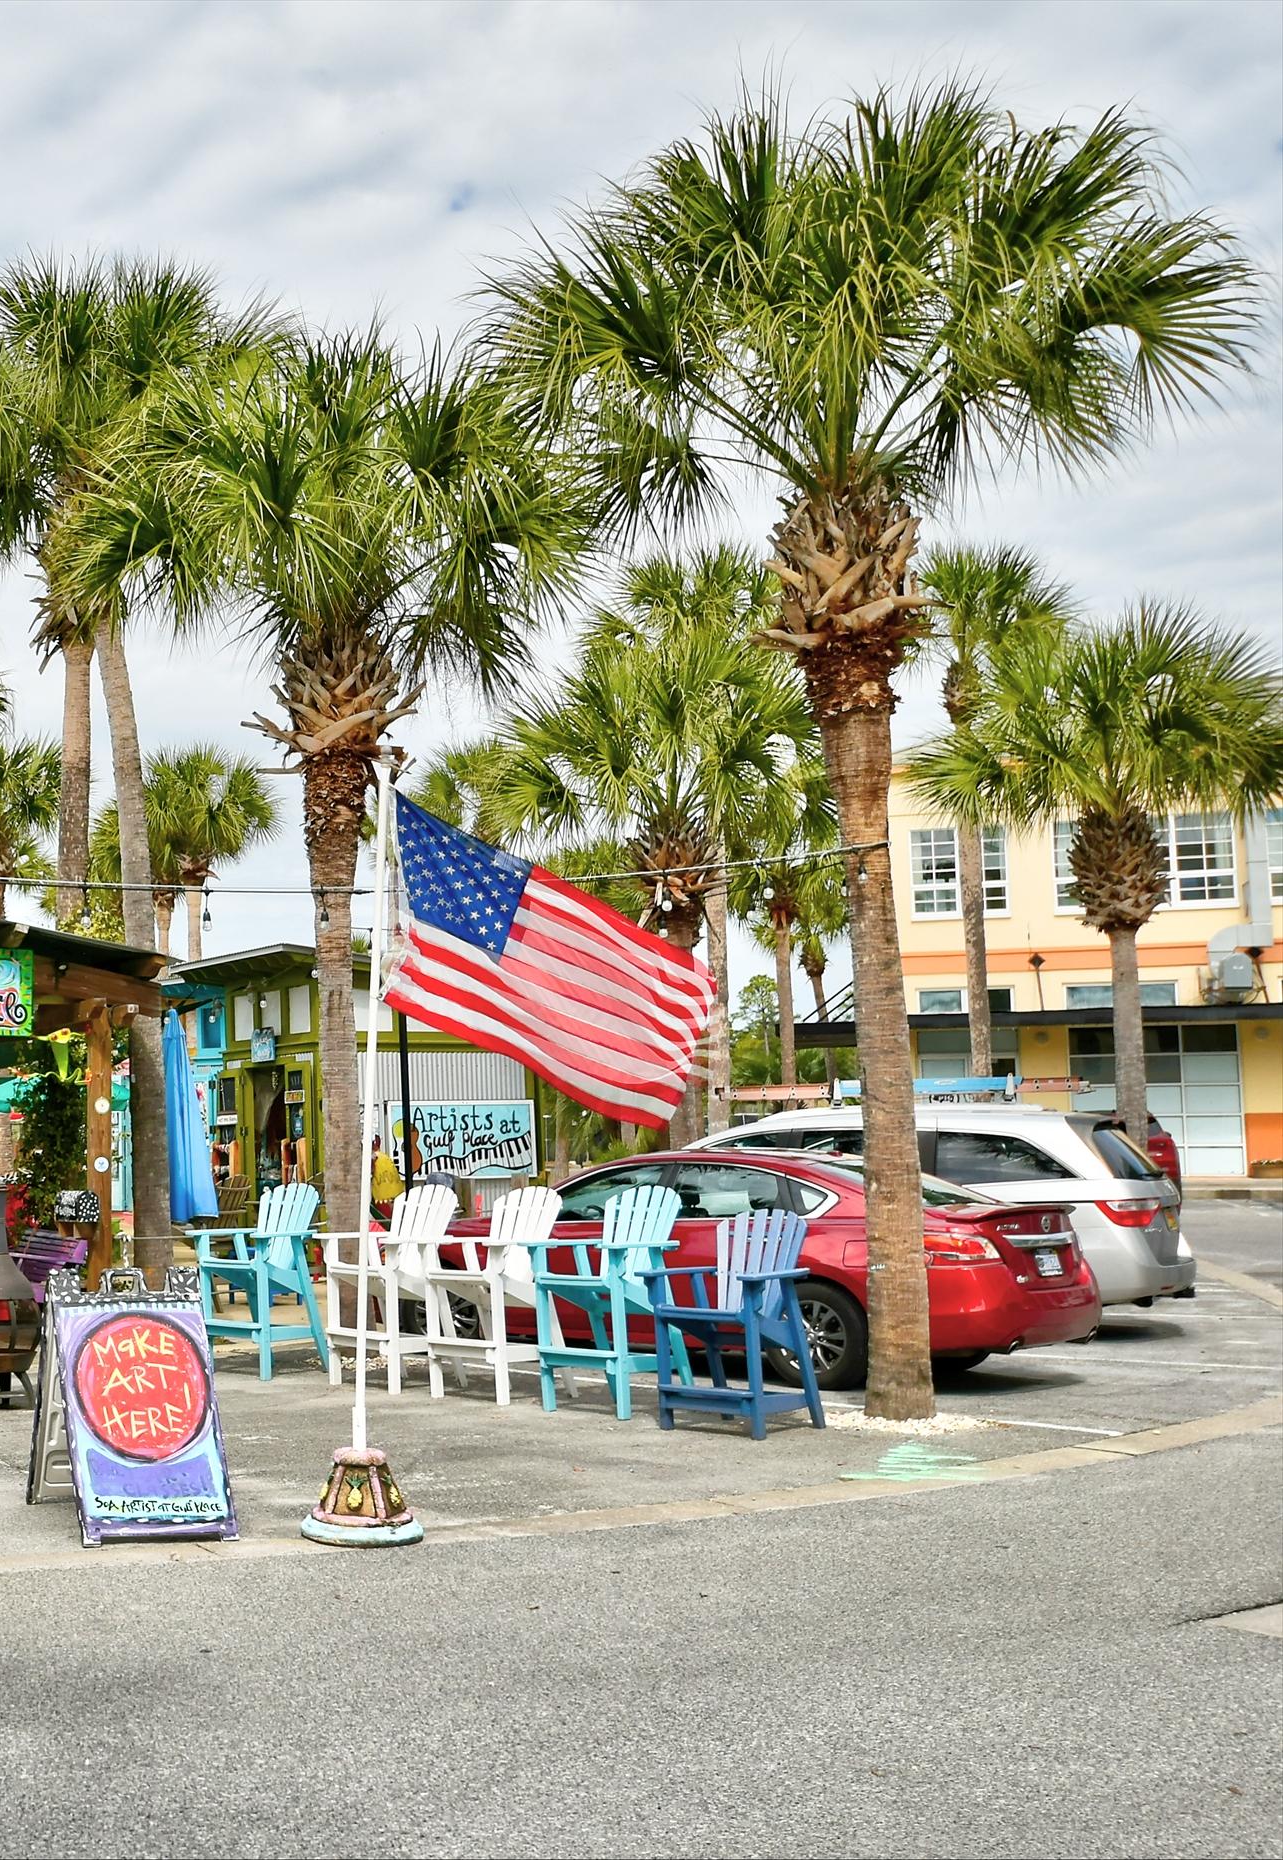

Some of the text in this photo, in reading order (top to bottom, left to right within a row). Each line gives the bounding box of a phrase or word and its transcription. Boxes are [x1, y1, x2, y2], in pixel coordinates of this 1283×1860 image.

[413, 1105, 521, 1135] Artists at
[101, 1362, 178, 1396] ART
